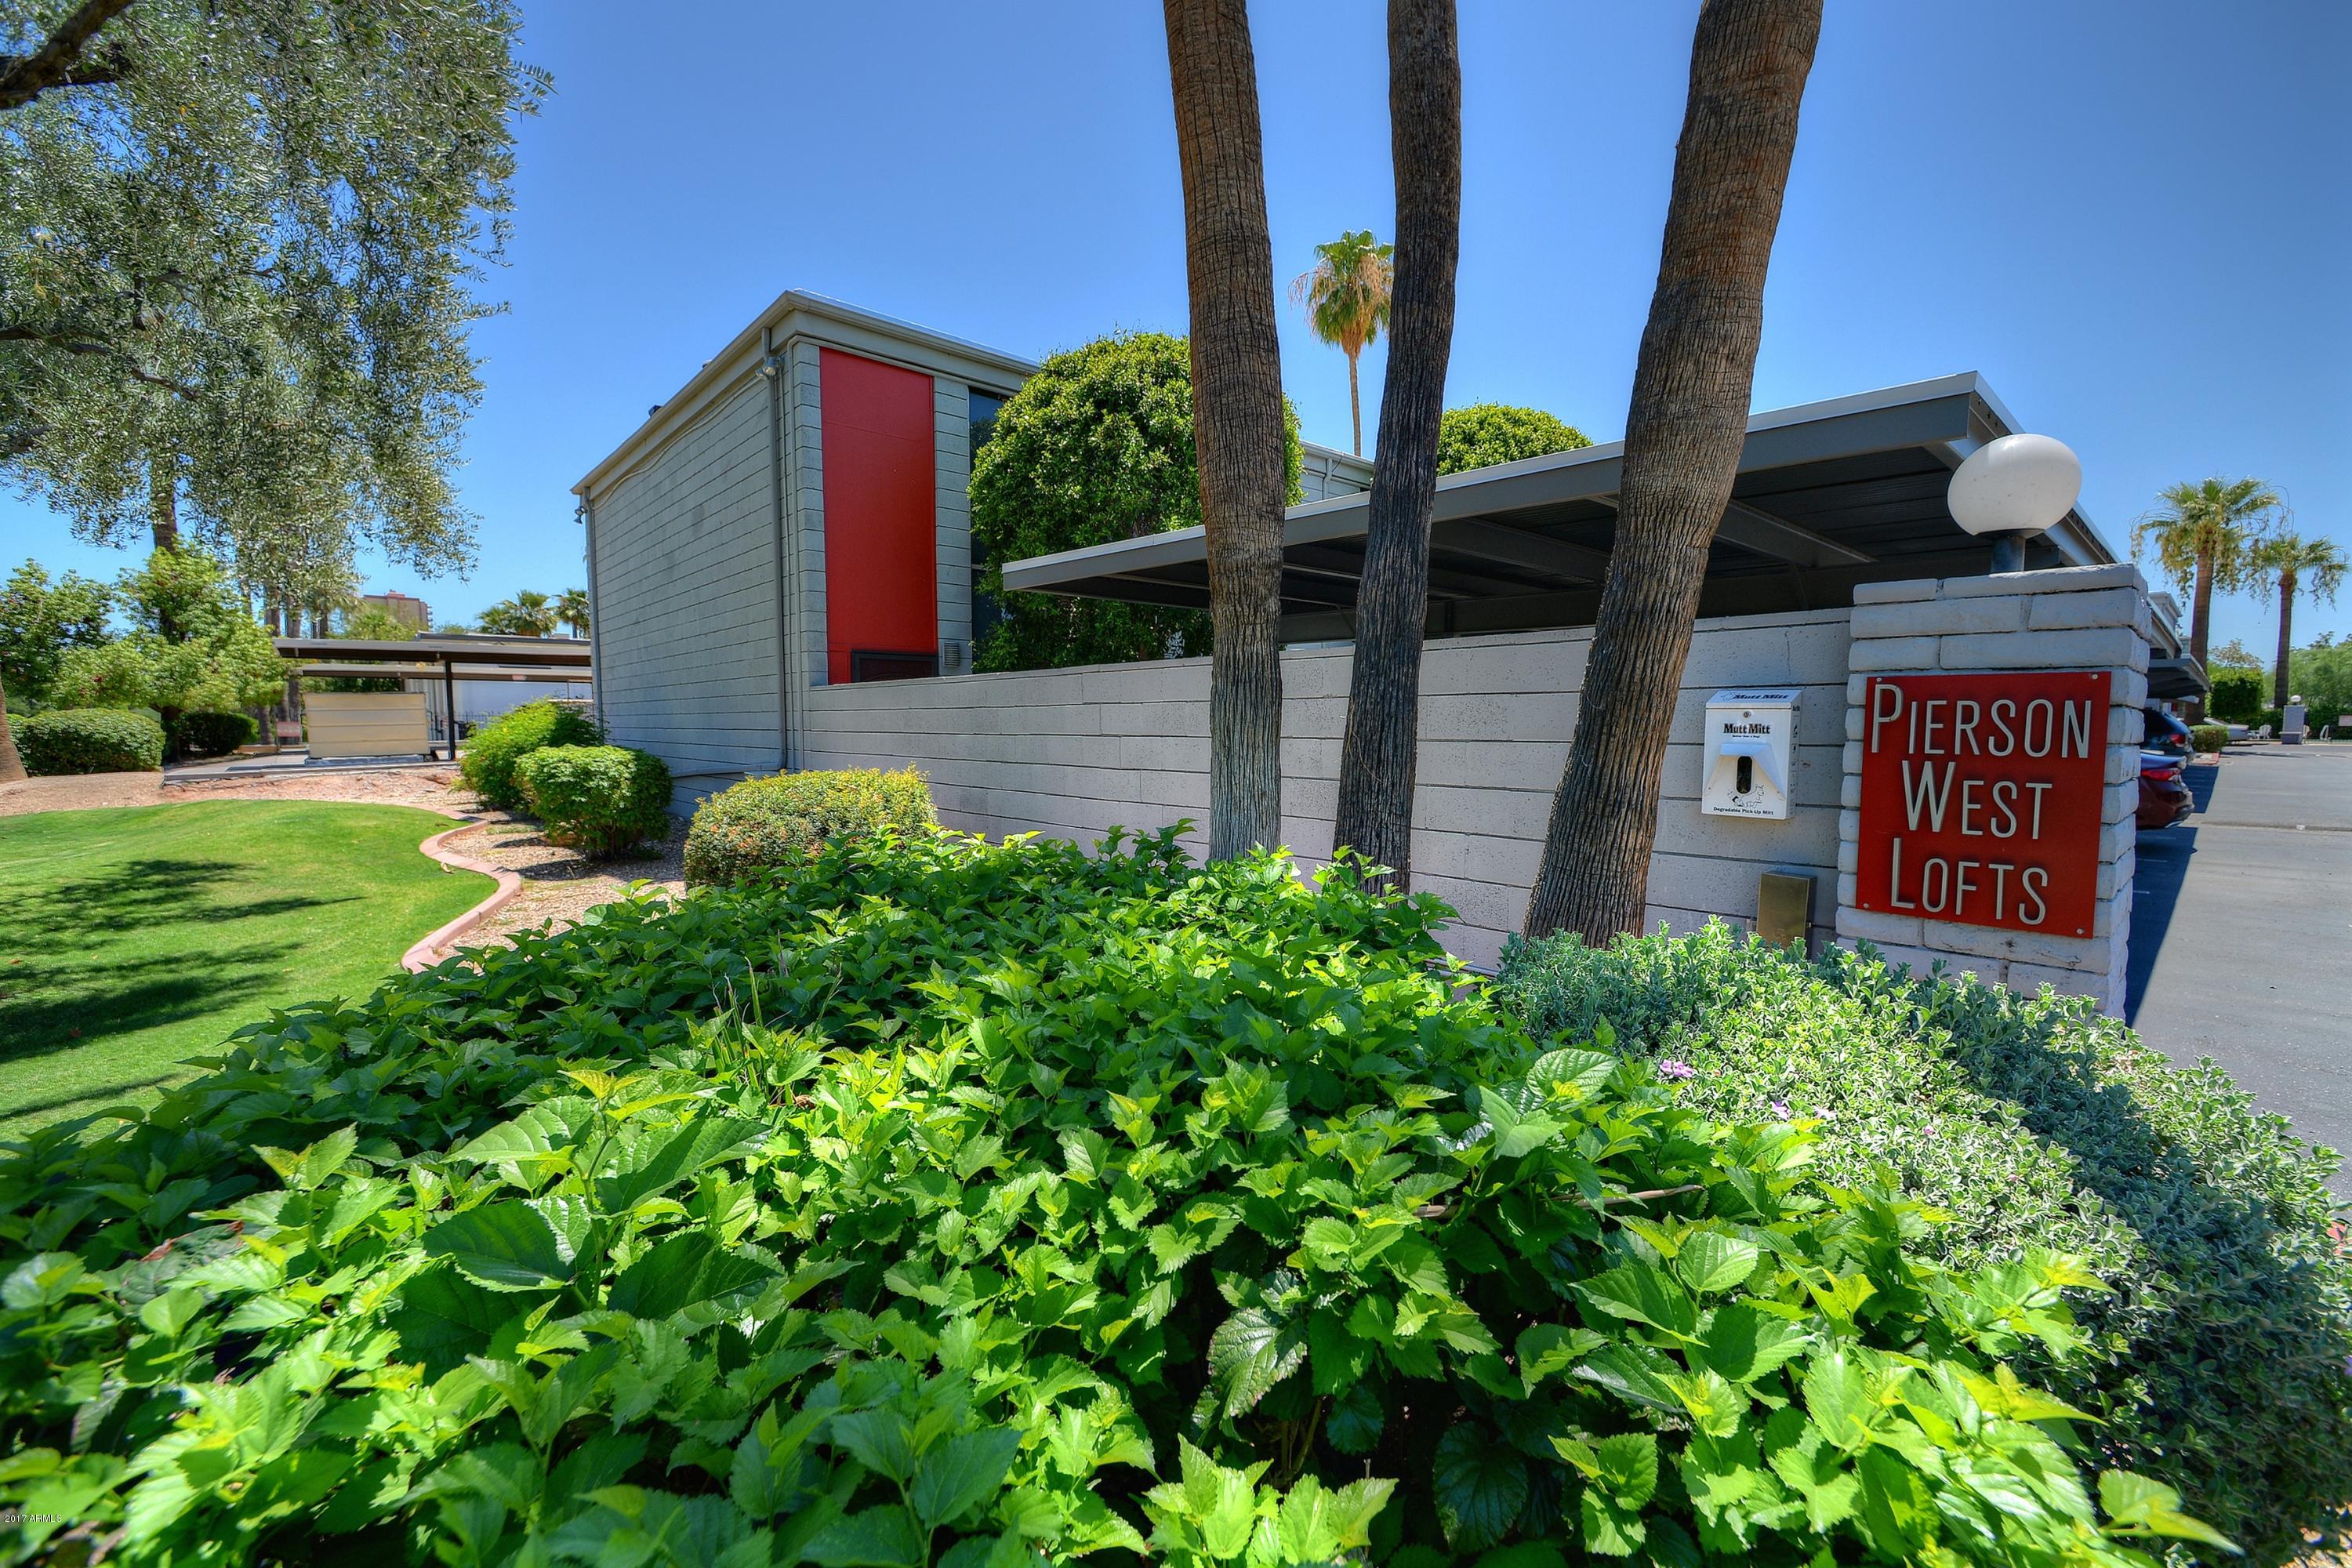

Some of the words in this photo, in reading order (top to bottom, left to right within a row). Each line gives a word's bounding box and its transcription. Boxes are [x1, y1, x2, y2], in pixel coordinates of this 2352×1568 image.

[1723, 723, 1748, 734] Mutt
[1748, 723, 1771, 734] Mitt
[1871, 684, 2092, 759] PIERSON
[1902, 760, 2053, 840] WEST
[1891, 837, 2049, 925] LOFTS
